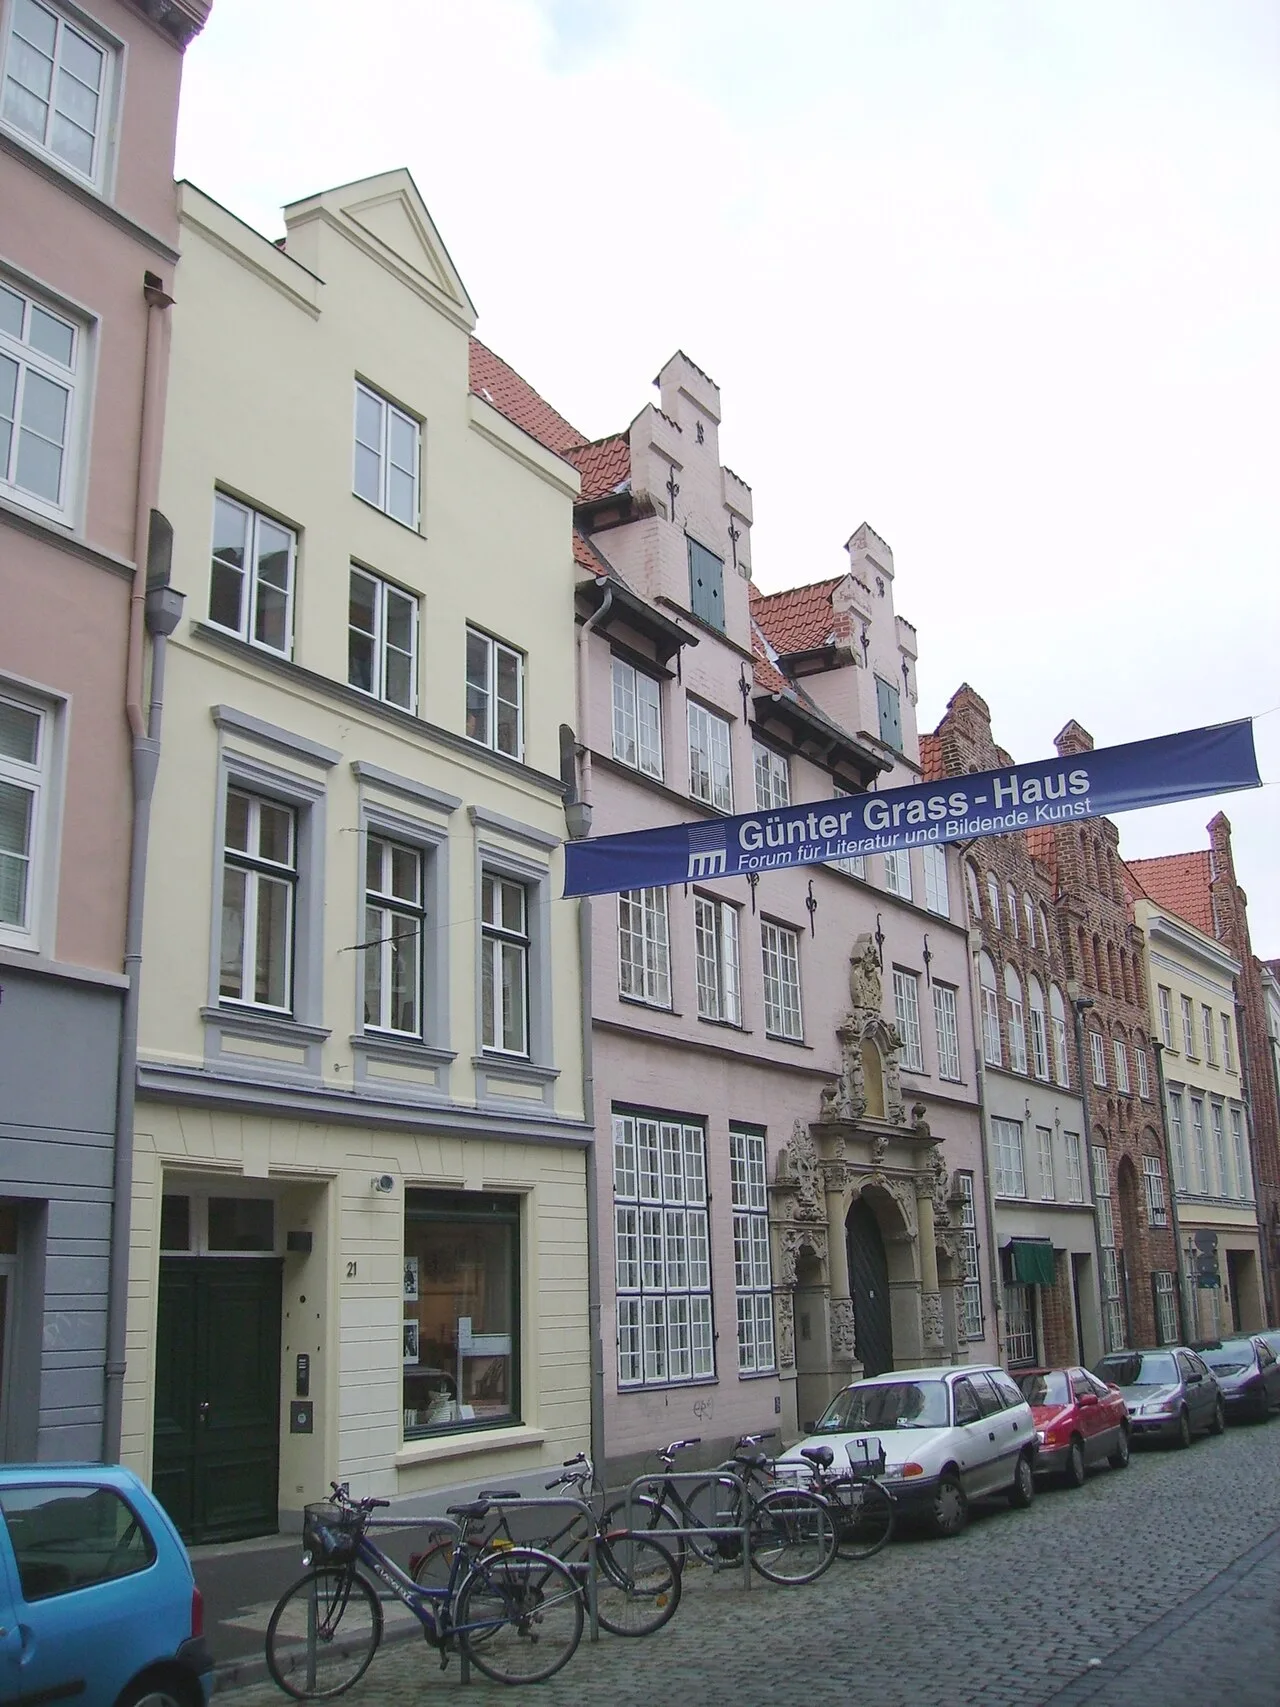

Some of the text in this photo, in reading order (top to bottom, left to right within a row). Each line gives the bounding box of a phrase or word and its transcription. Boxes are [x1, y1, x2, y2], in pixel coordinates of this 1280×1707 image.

[738, 797, 1092, 870] Forum für Literatur und Bildende Kunst
[739, 811, 852, 851] Günter
[346, 1261, 357, 1278] 21
